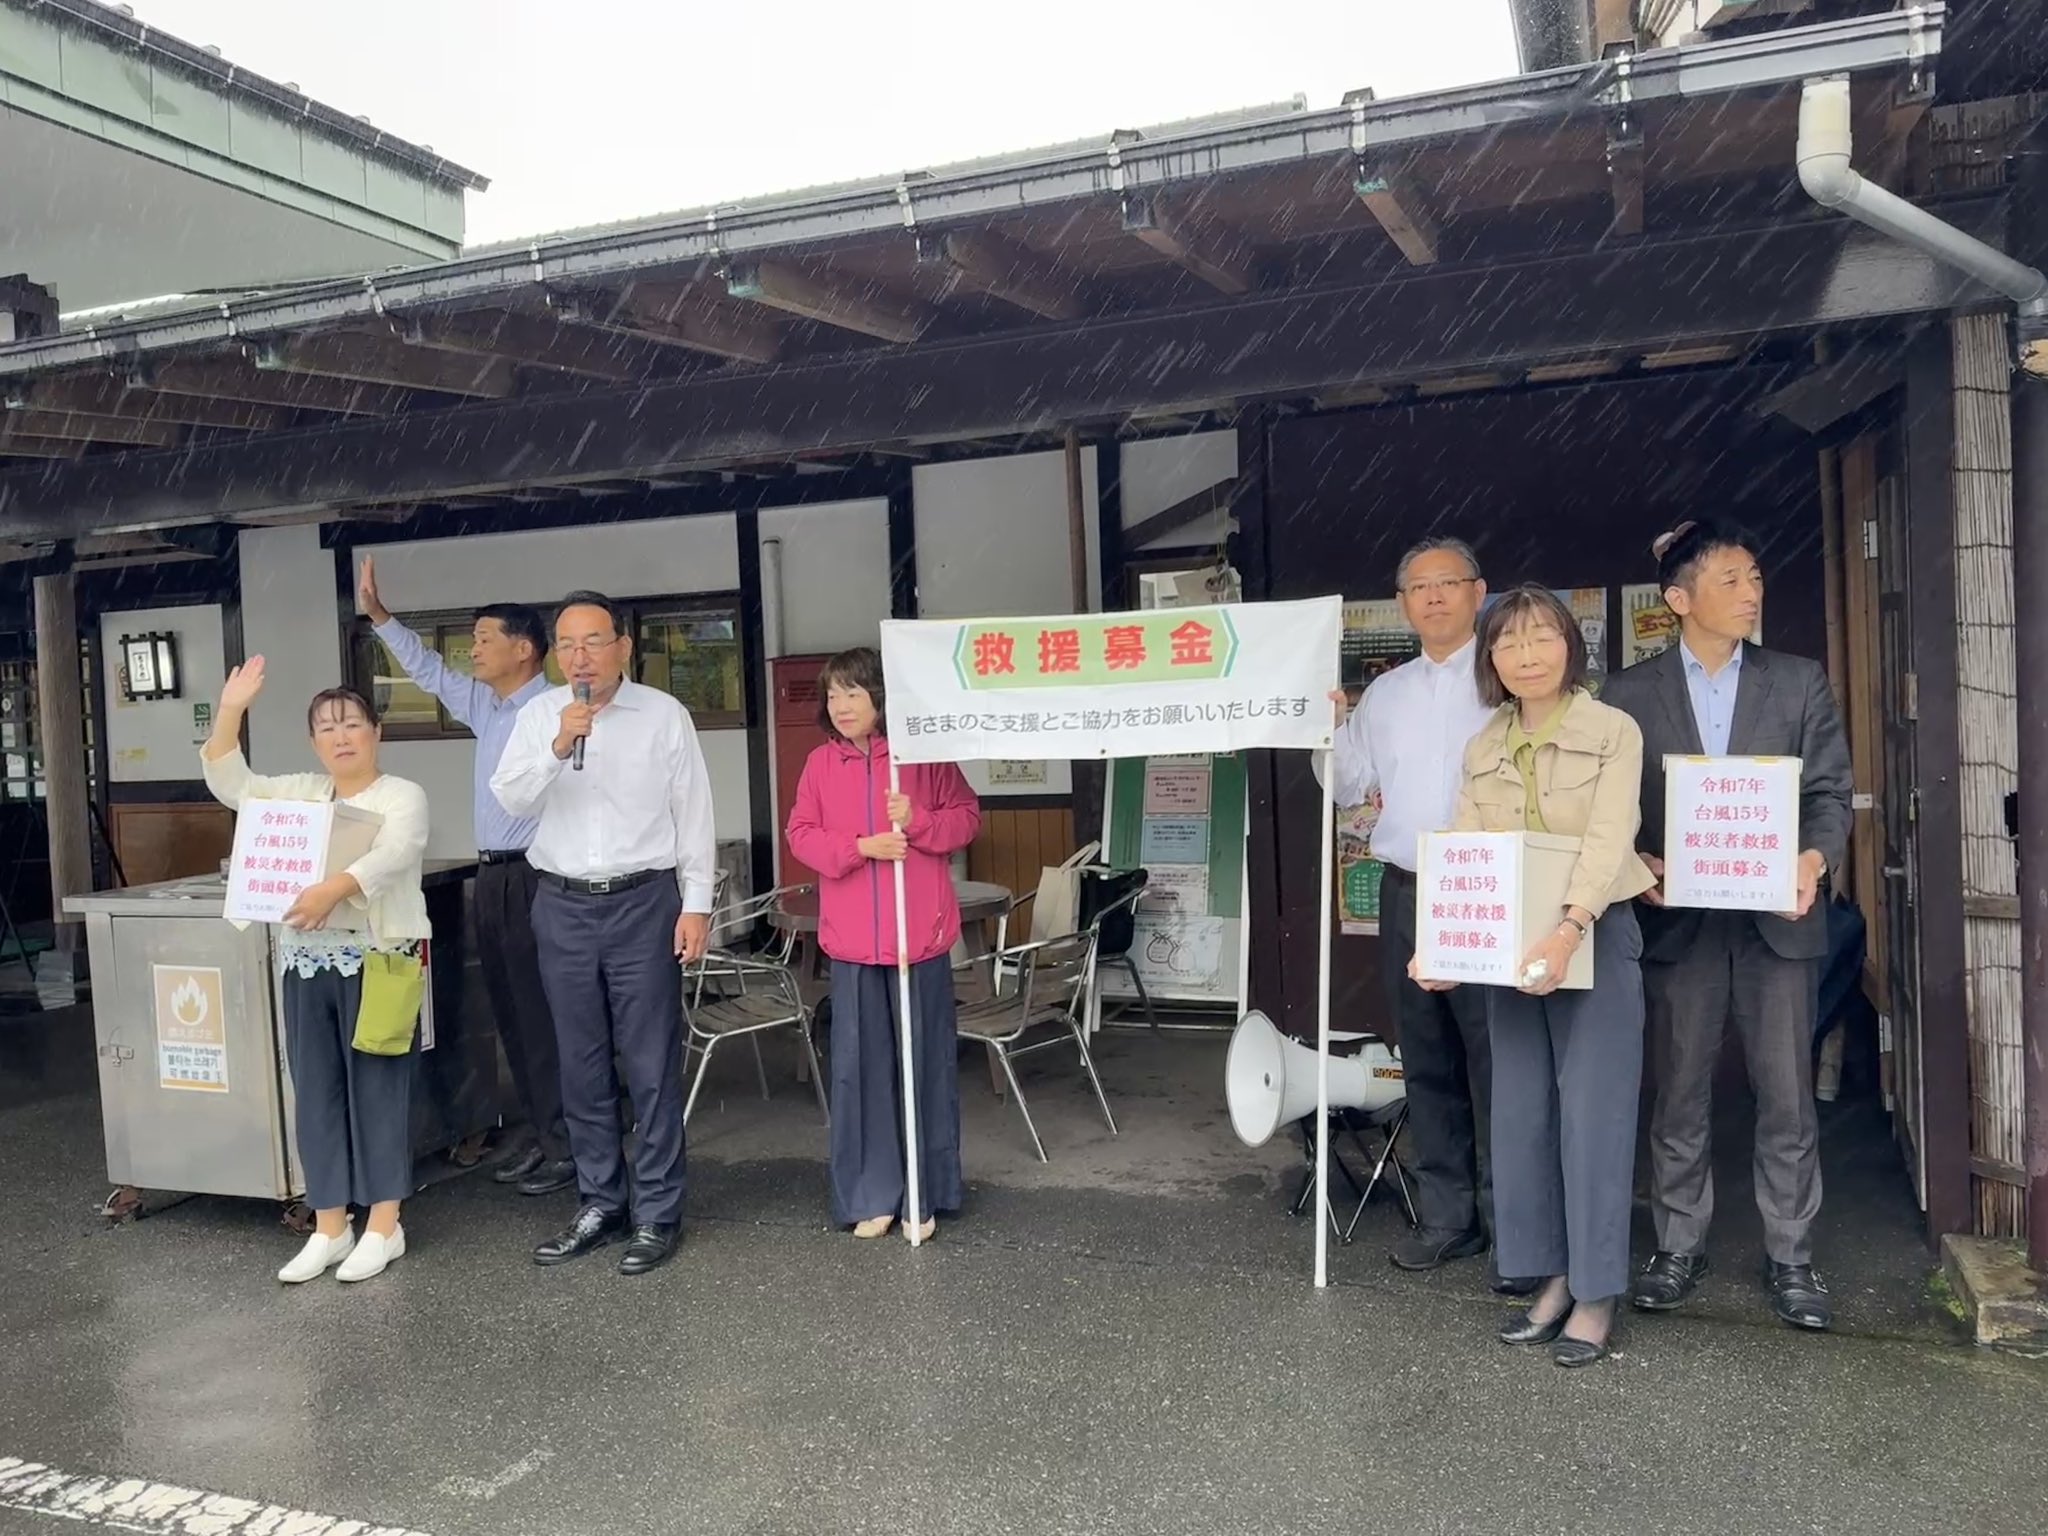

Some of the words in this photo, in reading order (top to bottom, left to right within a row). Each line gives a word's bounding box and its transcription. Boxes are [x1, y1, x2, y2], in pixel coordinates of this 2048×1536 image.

[973, 619, 1214, 676] 救援募金
[905, 696, 1310, 737] 皆さまのご支援とご協力をお願いいたします
[1700, 777, 1766, 794] 令和7年
[261, 811, 308, 827] 令和7年
[1695, 804, 1770, 822] 台風15号
[254, 833, 309, 850] 台風15号
[1684, 832, 1779, 850] 被災者救援
[244, 855, 313, 873] 被災者救援
[1443, 848, 1495, 864] 令和7年
[1694, 859, 1769, 877] 街頭募金
[247, 879, 303, 895] 街頭募金
[1440, 876, 1498, 893] 台風15号
[1432, 903, 1507, 921] 被災者救援
[1438, 930, 1498, 949] 街頭募金
